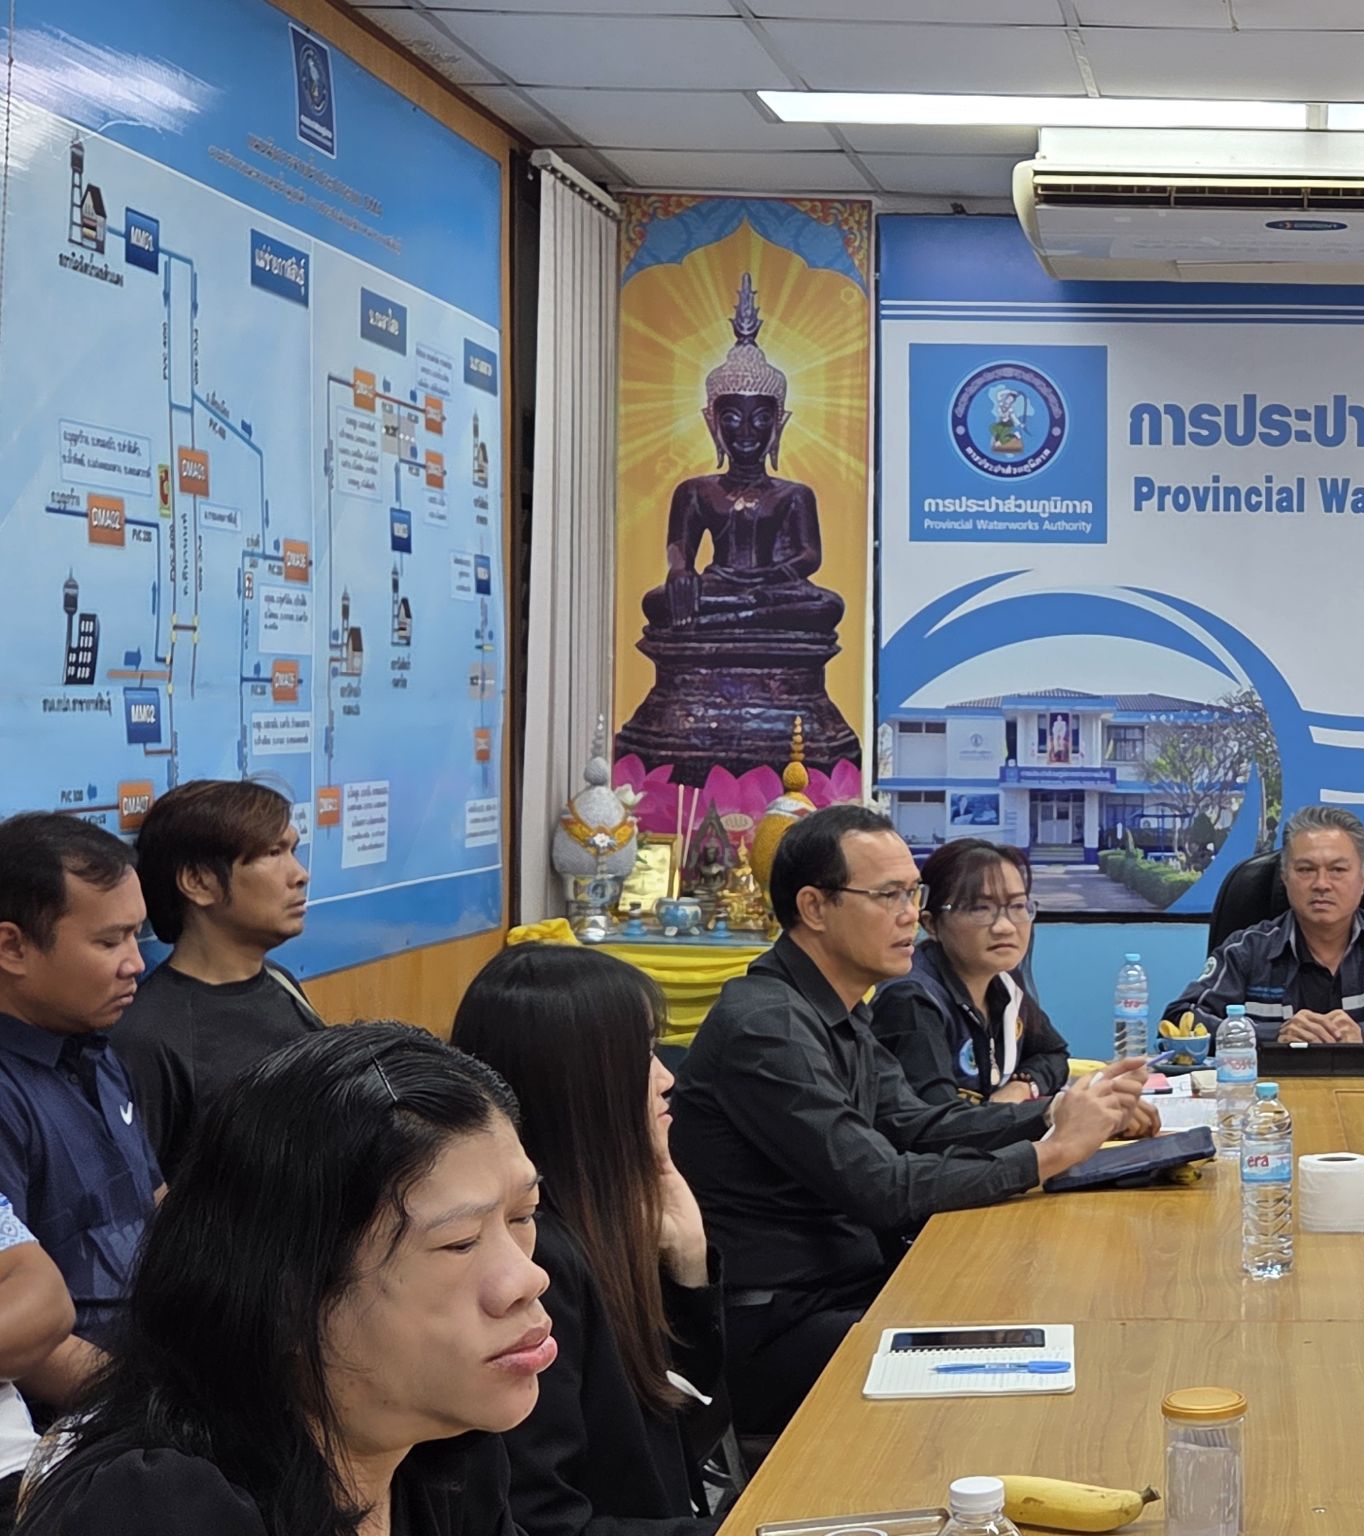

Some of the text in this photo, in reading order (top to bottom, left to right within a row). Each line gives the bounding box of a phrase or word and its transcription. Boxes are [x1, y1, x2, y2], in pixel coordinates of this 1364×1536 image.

[1133, 476, 1305, 513] Provincial
[924, 495, 1093, 517] การประปาส่วนภูมิภาค
[924, 518, 1092, 534] Provincial Waterworks Authority
[1247, 1154, 1270, 1168] era
